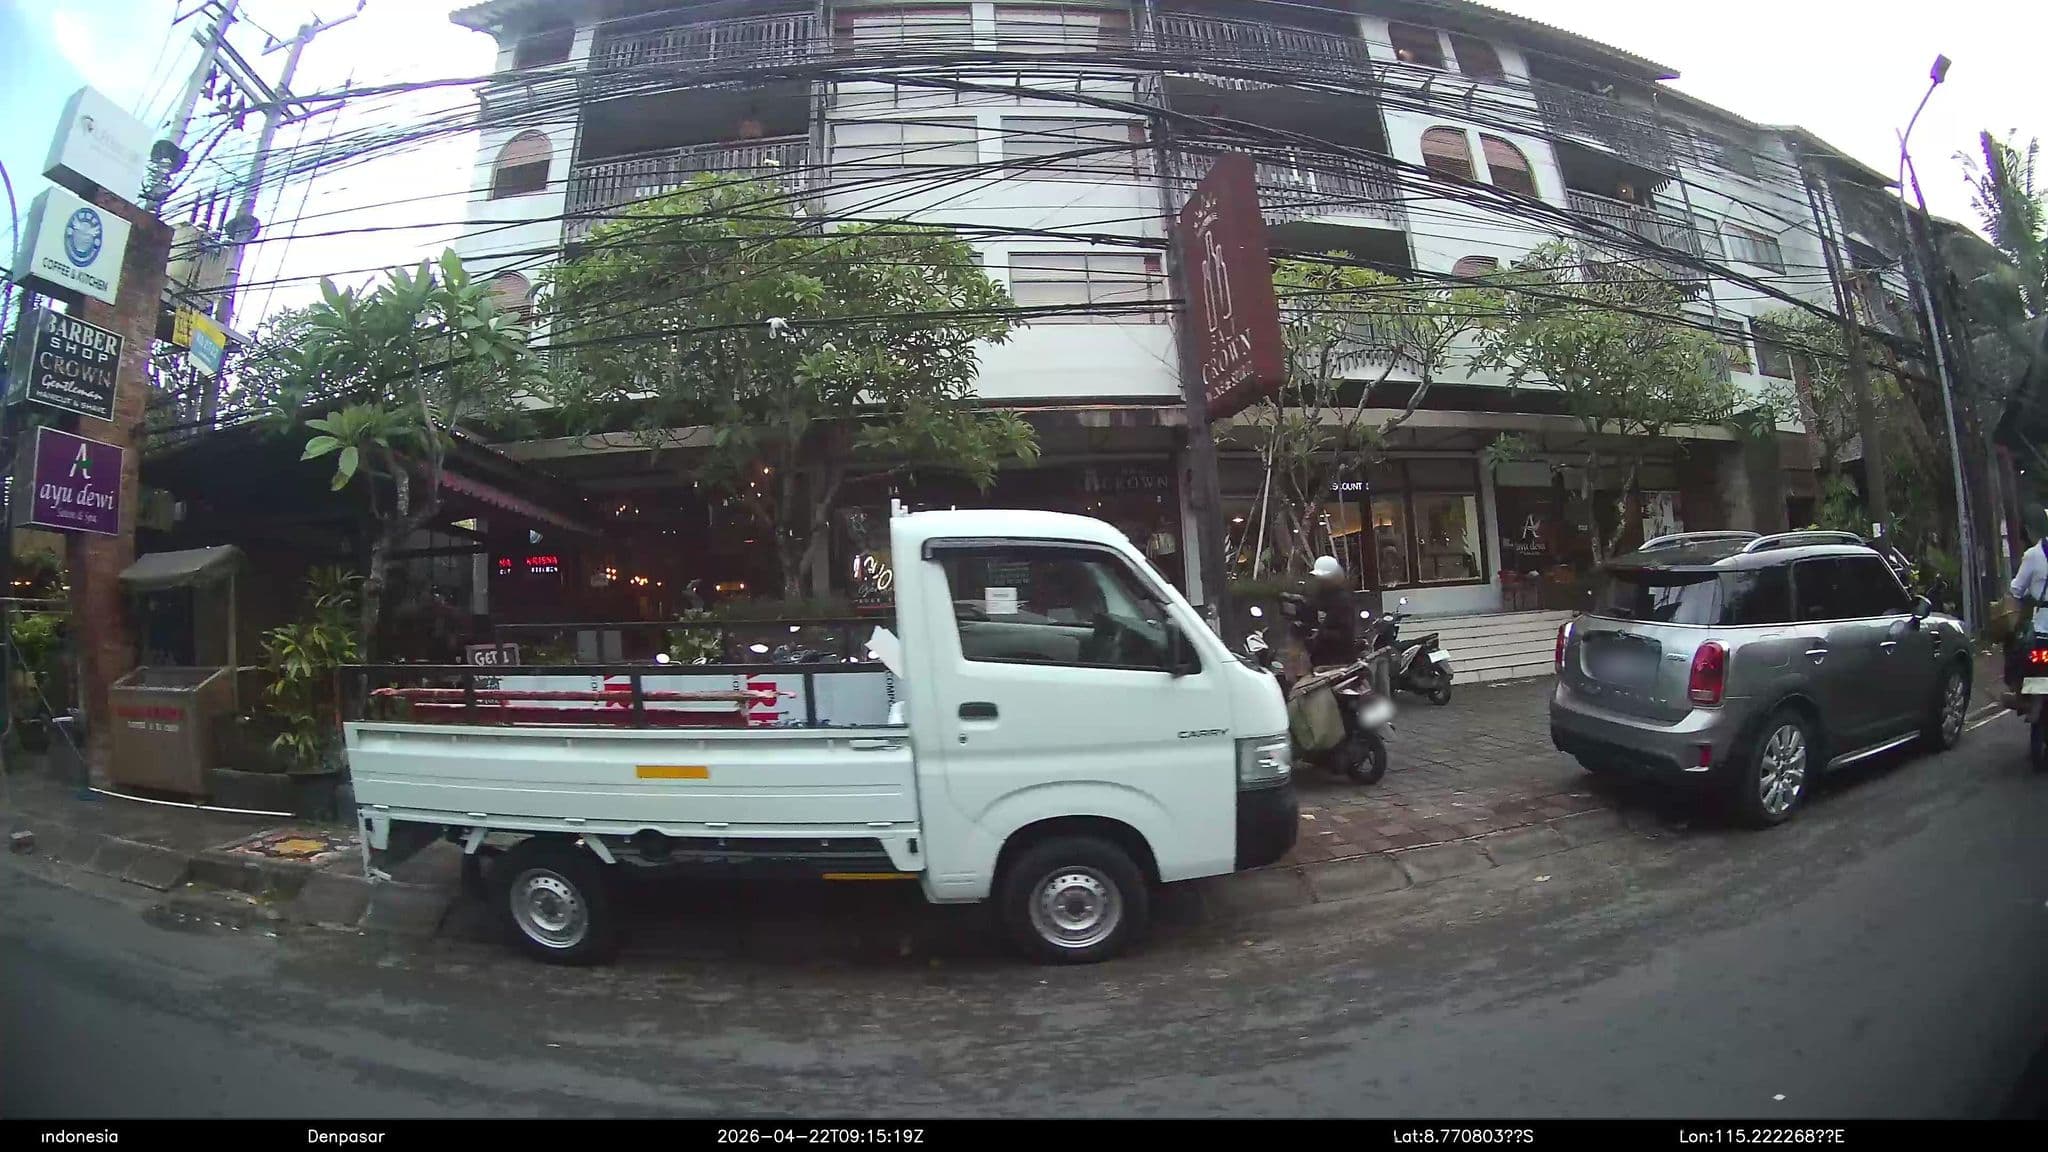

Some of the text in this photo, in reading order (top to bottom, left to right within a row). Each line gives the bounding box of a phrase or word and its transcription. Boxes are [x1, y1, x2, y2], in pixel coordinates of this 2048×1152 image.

[43, 257, 71, 277] COFFEE
[78, 271, 109, 292] KITCHEN
[47, 313, 117, 356] BARBER
[49, 336, 109, 363] SHOP
[40, 351, 112, 388] CROWN
[40, 483, 115, 510] ayu dewi
[474, 651, 498, 667] GET
[1177, 728, 1229, 739] CARRY
